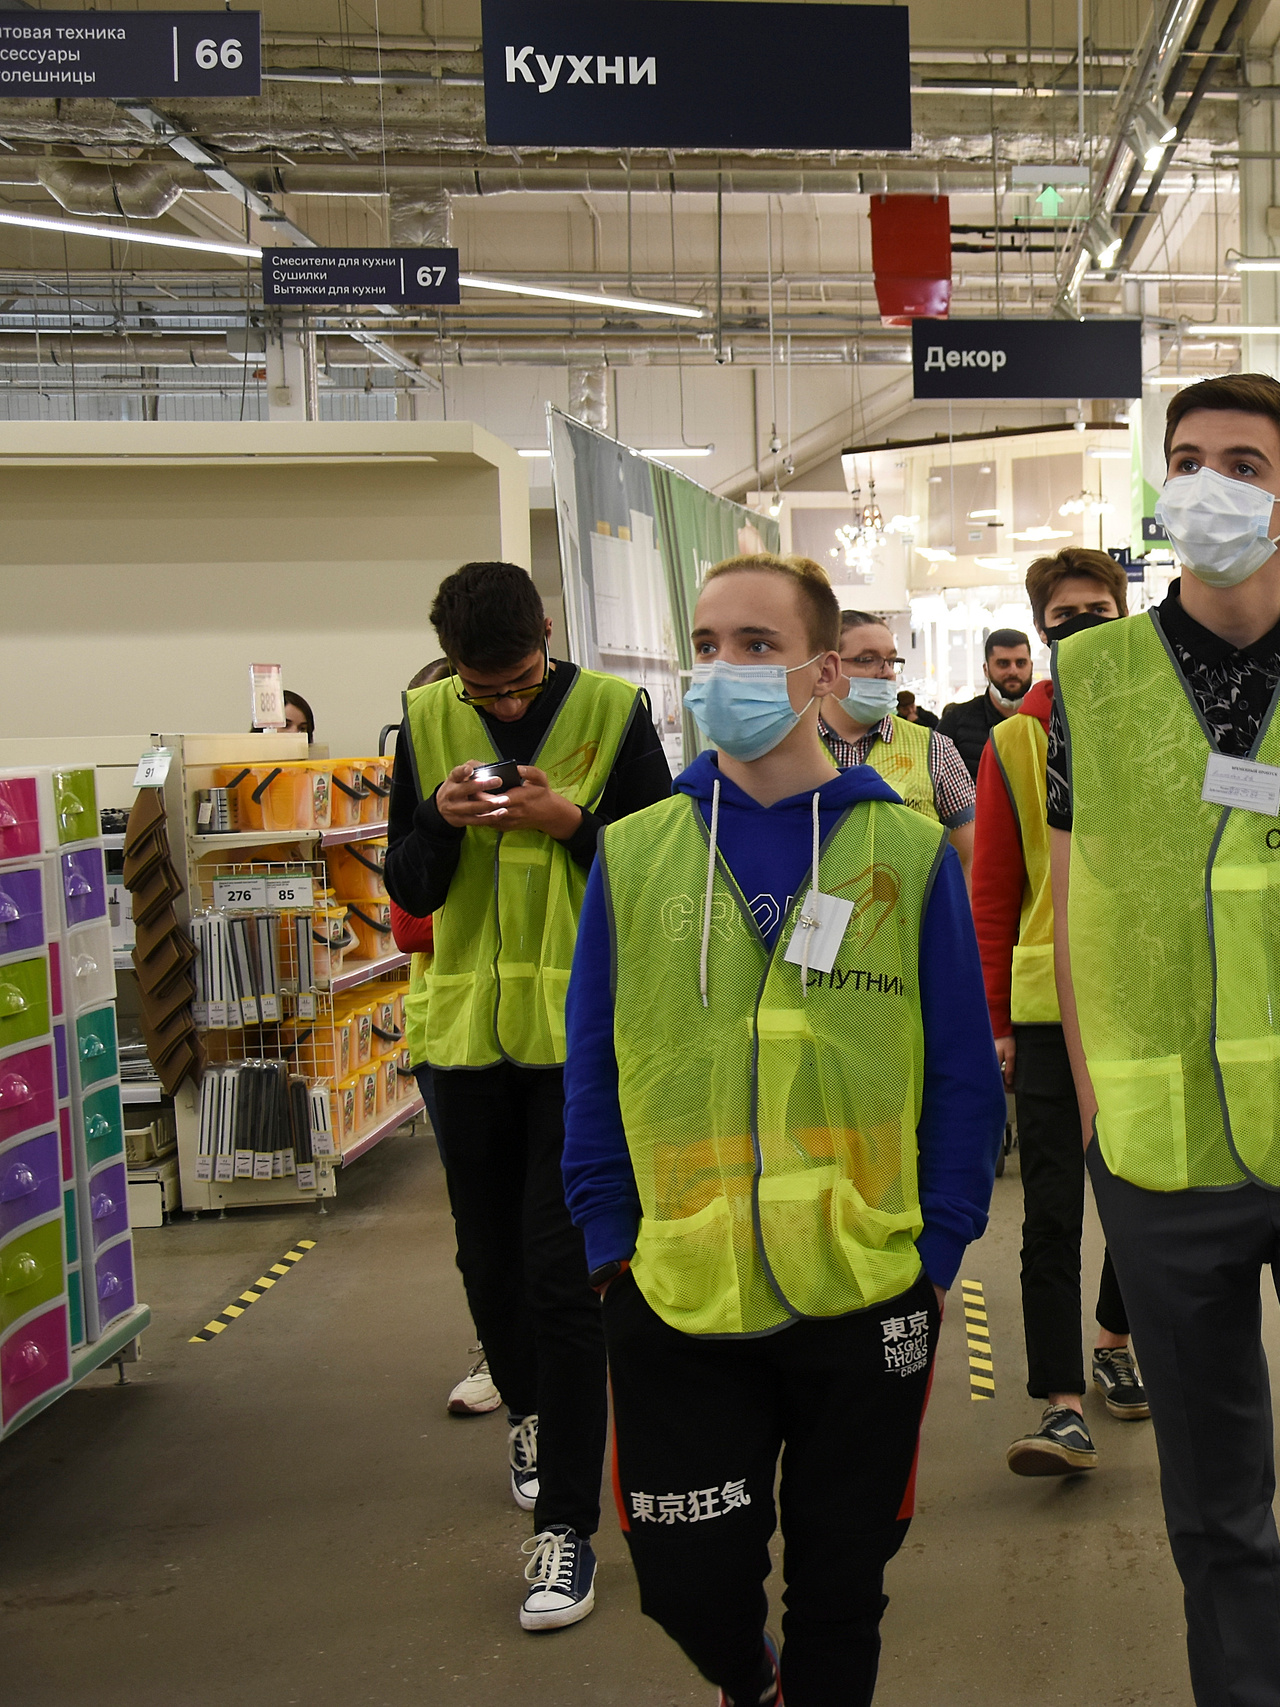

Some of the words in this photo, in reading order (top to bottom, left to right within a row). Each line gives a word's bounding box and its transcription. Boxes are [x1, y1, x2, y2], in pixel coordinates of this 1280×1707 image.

[55, 27, 126, 40] техника
[195, 38, 243, 70] 66
[505, 45, 657, 93] Кухни
[271, 255, 336, 267] Смесители
[338, 258, 360, 268] для
[362, 258, 396, 268] кухни
[272, 270, 327, 282] Сушилки
[416, 266, 447, 287] 67
[273, 284, 326, 295] Вытяжки
[328, 286, 350, 297] для
[352, 286, 386, 296] кухни
[924, 346, 1007, 373] Декор
[1148, 523, 1157, 535] 8
[144, 767, 155, 778] 91
[227, 890, 252, 902] 276
[278, 889, 295, 901] 85
[880, 1310, 930, 1343] 東京
[630, 1477, 752, 1525] 東京狂気
